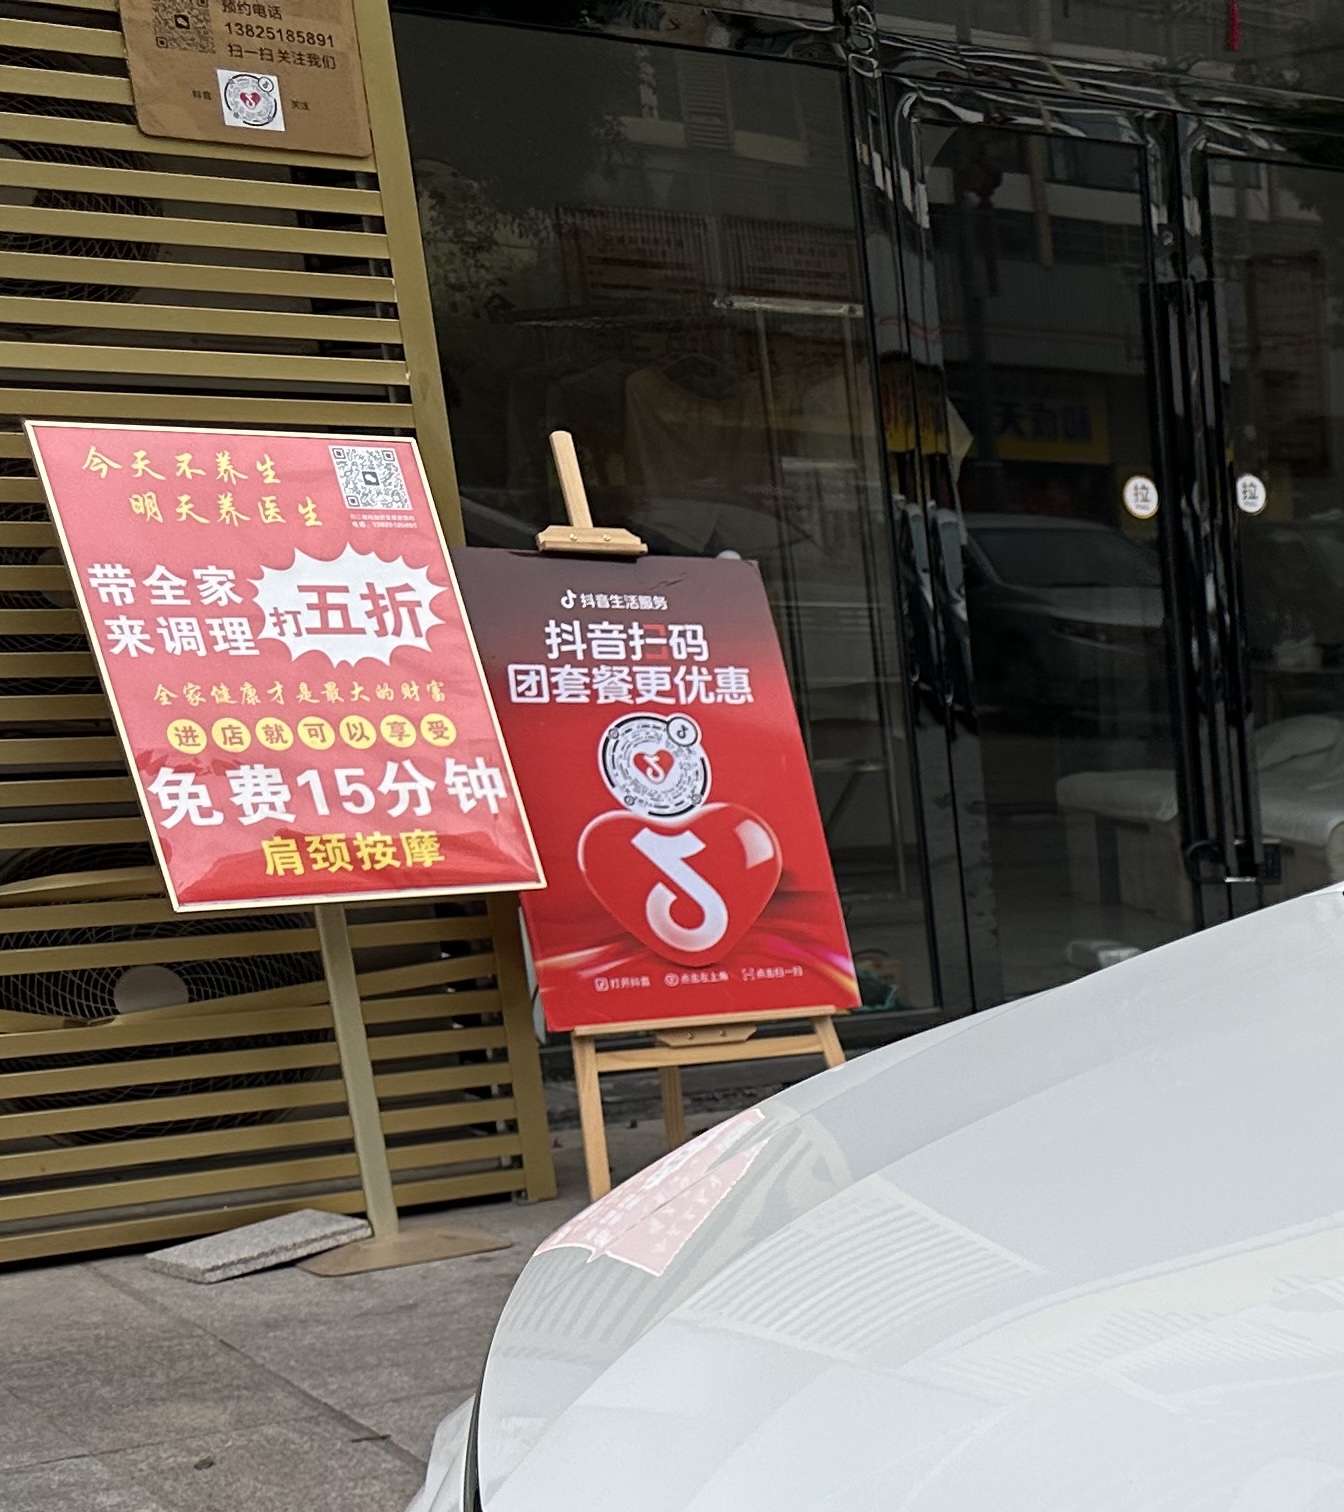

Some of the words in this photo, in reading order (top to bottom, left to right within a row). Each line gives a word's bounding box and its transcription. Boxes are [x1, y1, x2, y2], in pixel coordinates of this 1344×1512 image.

[222, 0, 283, 20] 预约电话
[225, 22, 335, 48] 13825185891
[228, 43, 275, 63] 扫一扫
[277, 49, 337, 70] 关注我们
[82, 444, 282, 486] 今天不养生
[129, 491, 324, 528] 明天养医生
[87, 562, 244, 608] 带全家
[579, 592, 668, 610] 抖音生活服务
[269, 581, 424, 641] 打五折
[103, 614, 261, 659] 来调理
[544, 619, 710, 662] 抖音扫码
[152, 679, 447, 708] 全家健康才是最大的财富
[507, 663, 755, 705] 团套餐更优惠
[171, 716, 453, 750] 进店就可以享受
[147, 757, 509, 830] 免费15分钟
[261, 828, 446, 877] 肩颈按摩
